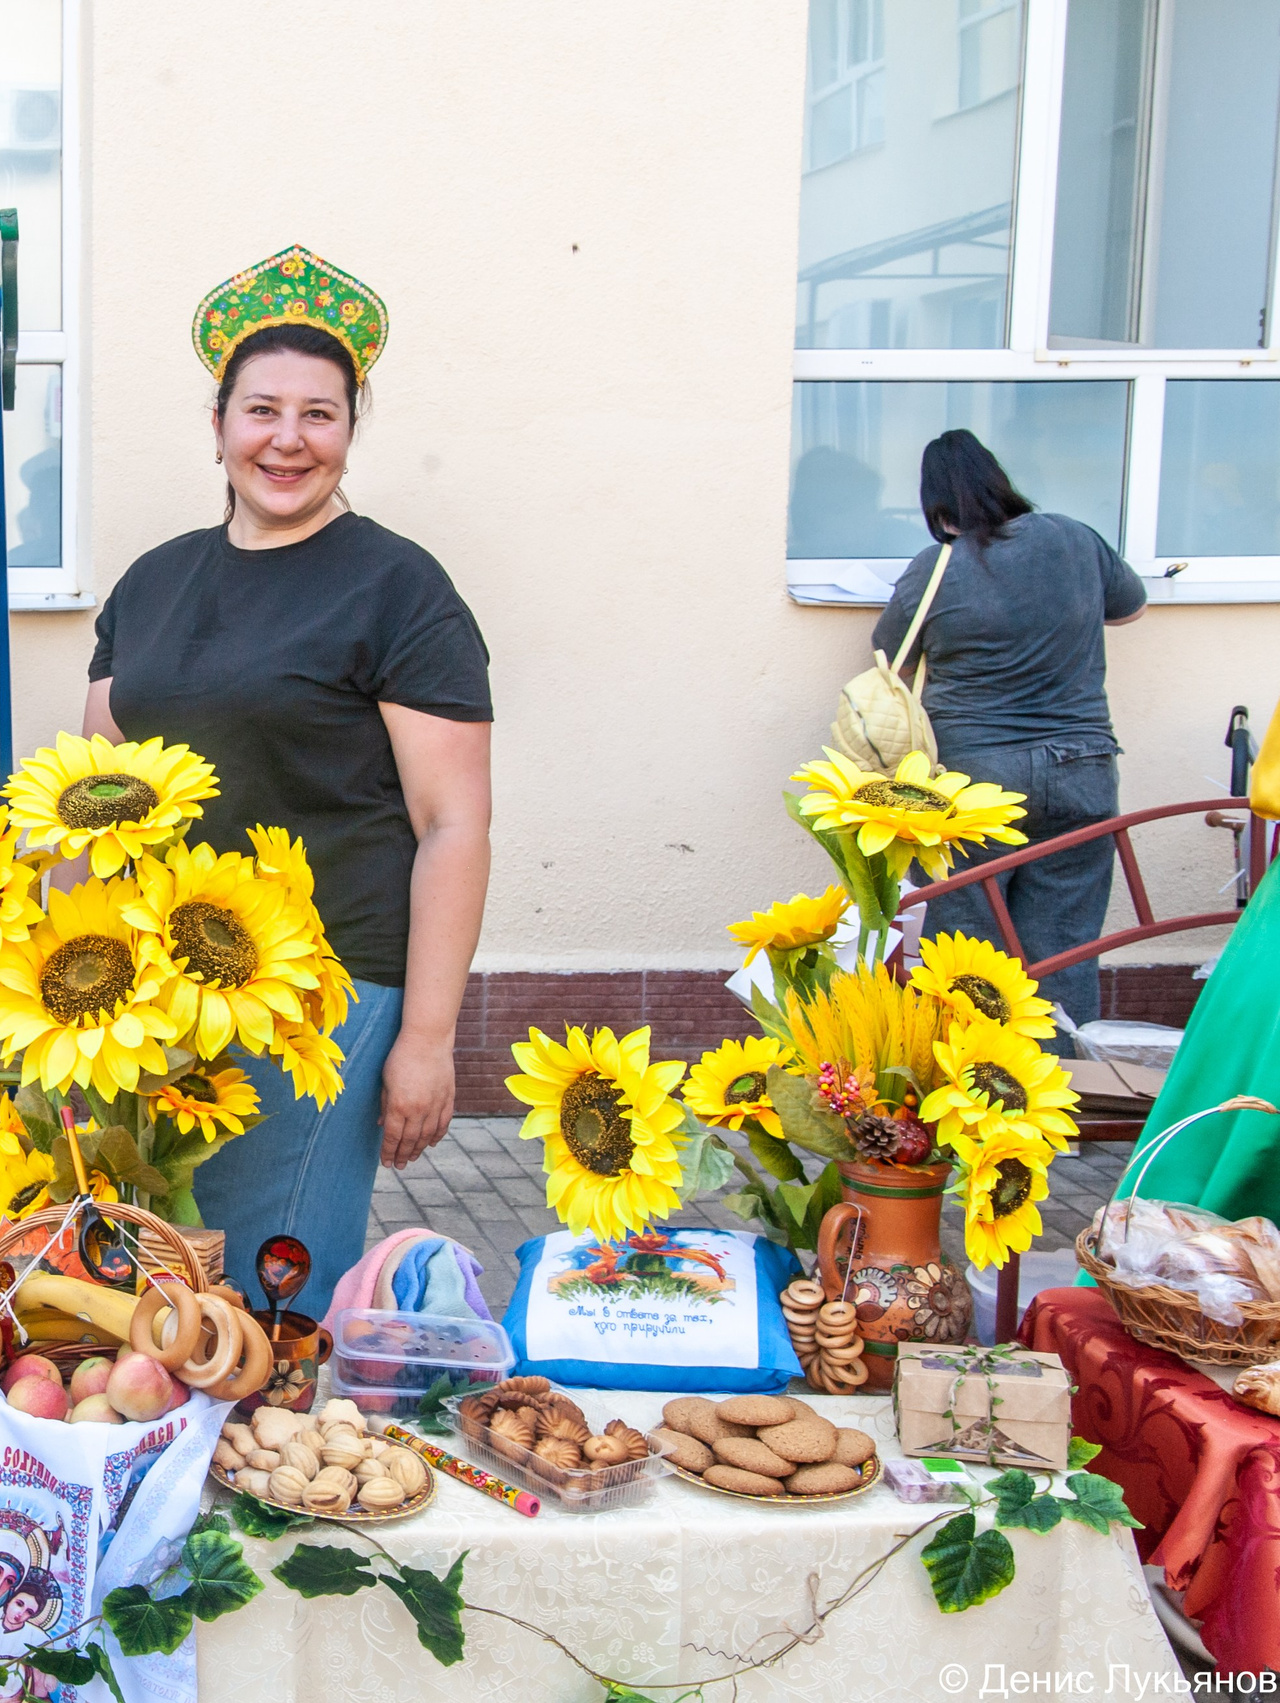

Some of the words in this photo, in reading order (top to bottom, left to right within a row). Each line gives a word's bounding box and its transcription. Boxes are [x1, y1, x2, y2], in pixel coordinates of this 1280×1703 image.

[568, 1305, 596, 1317] Мы
[602, 1306, 611, 1317] в
[616, 1308, 660, 1321] ответе
[664, 1313, 677, 1325] за
[594, 1321, 617, 1335] кого
[623, 1322, 686, 1338] приручили
